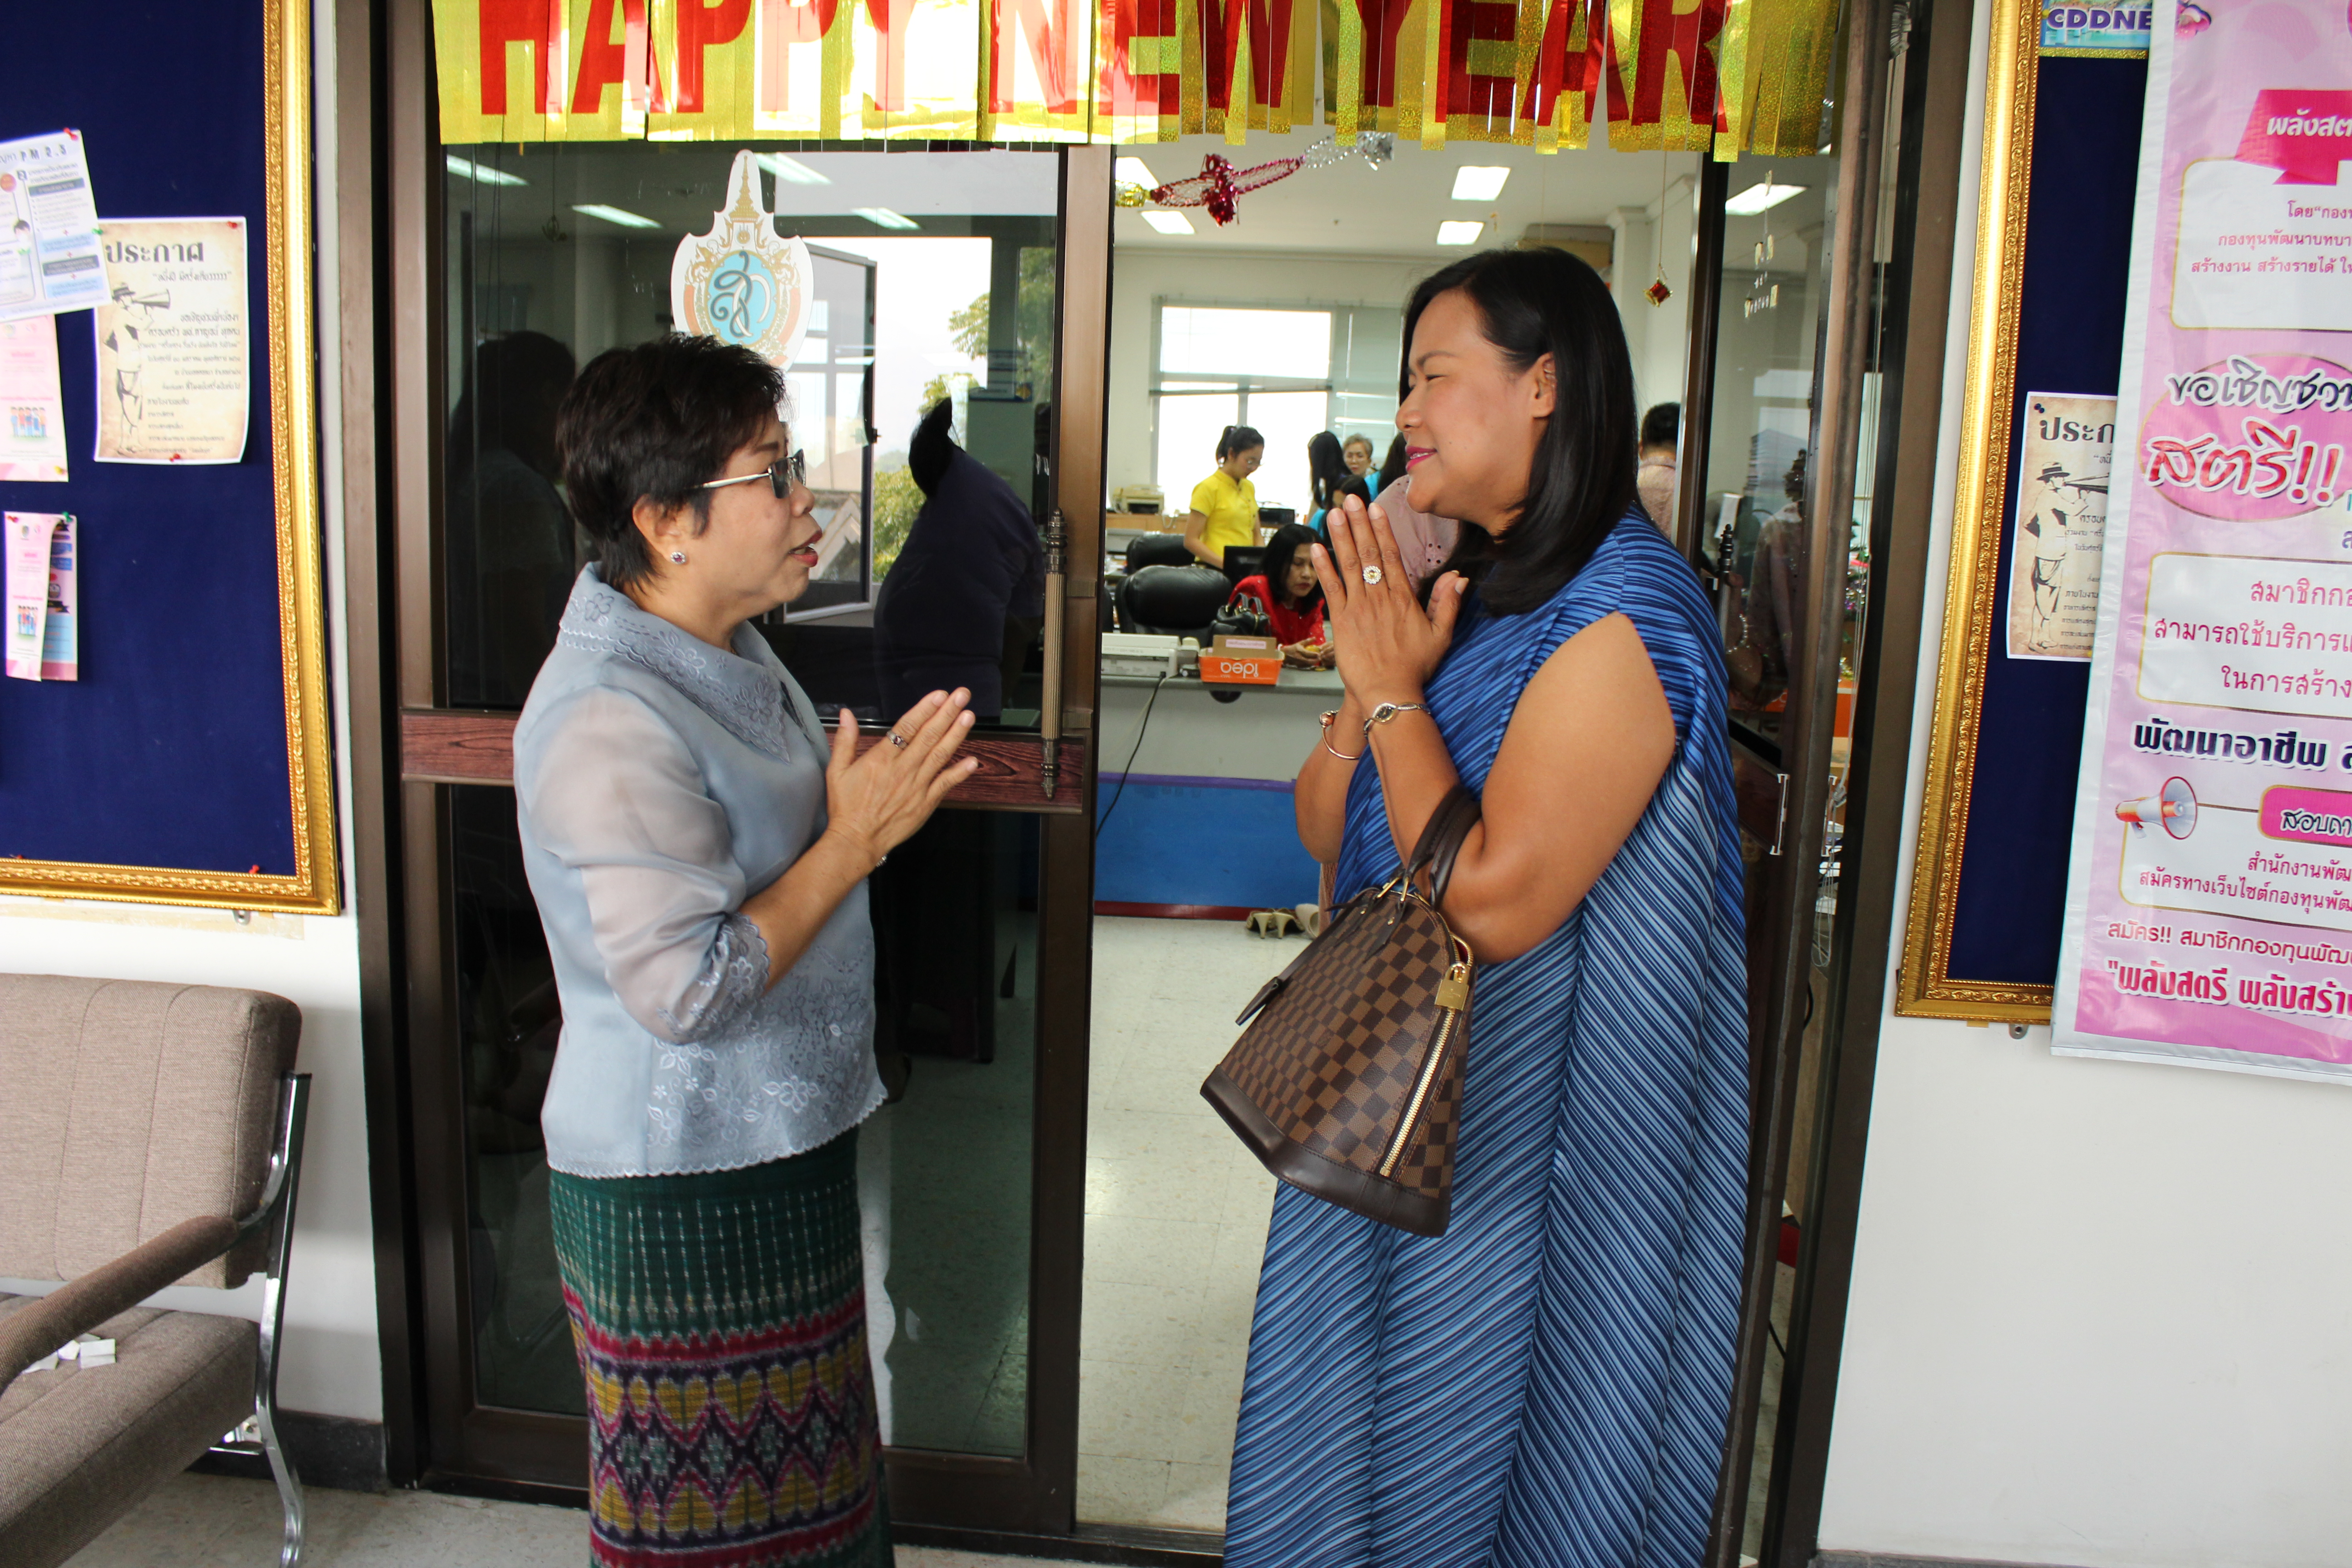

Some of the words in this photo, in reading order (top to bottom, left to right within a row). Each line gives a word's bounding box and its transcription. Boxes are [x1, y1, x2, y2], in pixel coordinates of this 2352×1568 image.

[480, 0, 915, 115] HAPPY
[989, 0, 1293, 117] NEW
[1356, 0, 1730, 132] YEAR
[105, 241, 204, 263] ประกาศ
[2218, 229, 2351, 250] กองทุนพัฒนาบทบา
[2191, 257, 2251, 273] สร้างงาน
[2257, 255, 2337, 273] สร้างรายได้
[2147, 421, 2340, 502] สตรี!!
[1220, 662, 1259, 679] idea
[2133, 717, 2328, 767] พัฒนาอาชีพ
[2180, 931, 2352, 964] สมาชิกกองทุนพัฒ
